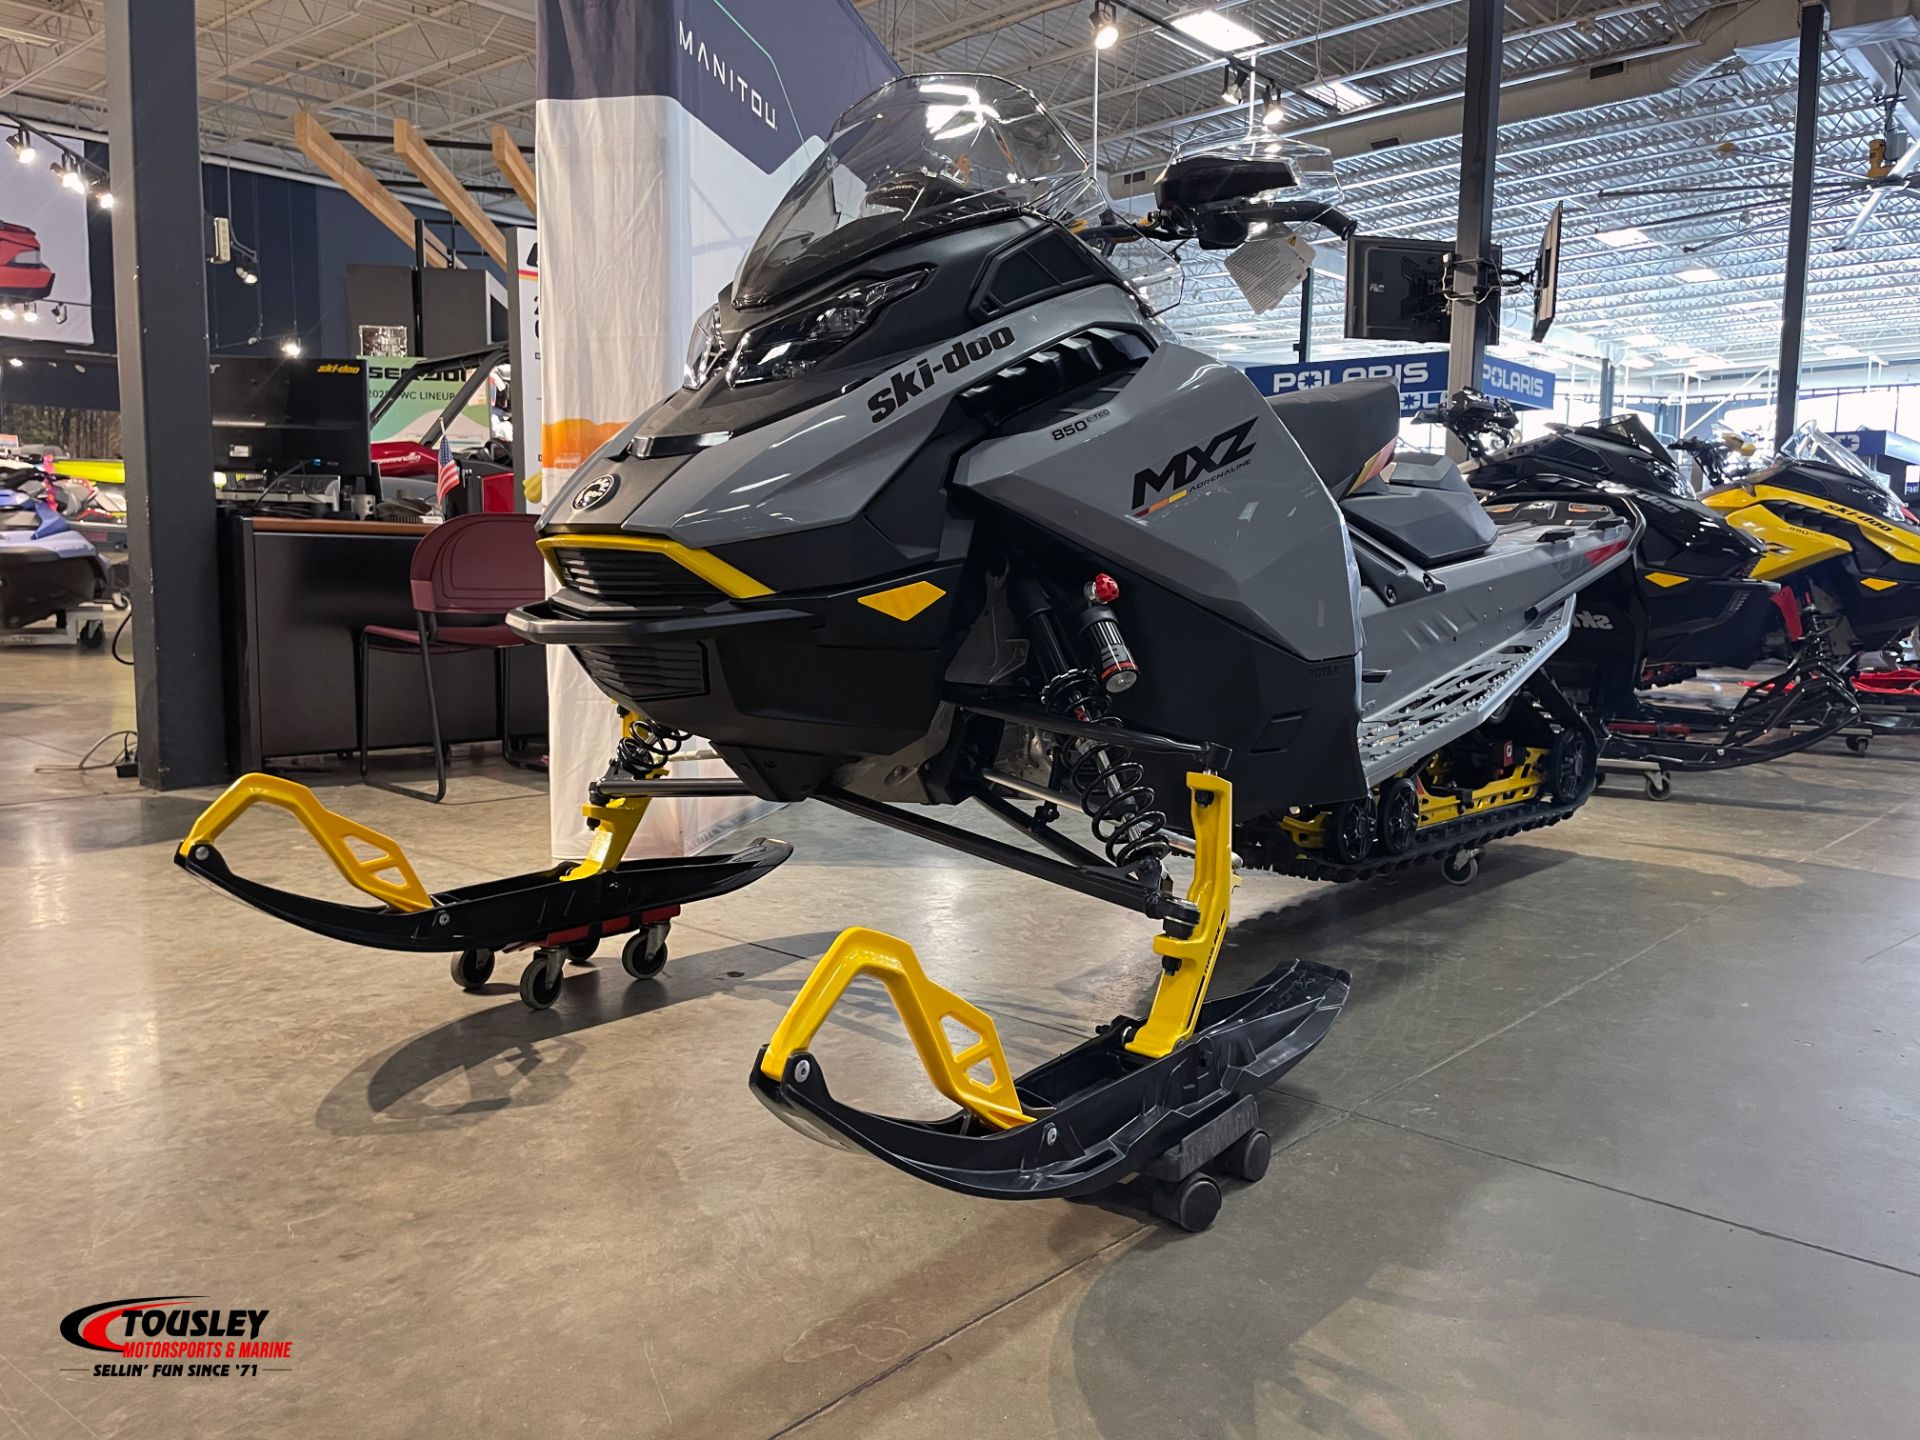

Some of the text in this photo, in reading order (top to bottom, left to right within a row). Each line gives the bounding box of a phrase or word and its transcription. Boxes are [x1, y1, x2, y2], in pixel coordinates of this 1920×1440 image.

[679, 20, 777, 130] MANITOU
[1273, 362, 1429, 393] POLARIS
[1482, 363, 1544, 398] POLARIS
[1051, 420, 1088, 441] 850
[1131, 416, 1259, 510] MXZ
[1188, 459, 1253, 494] ADRENALINE
